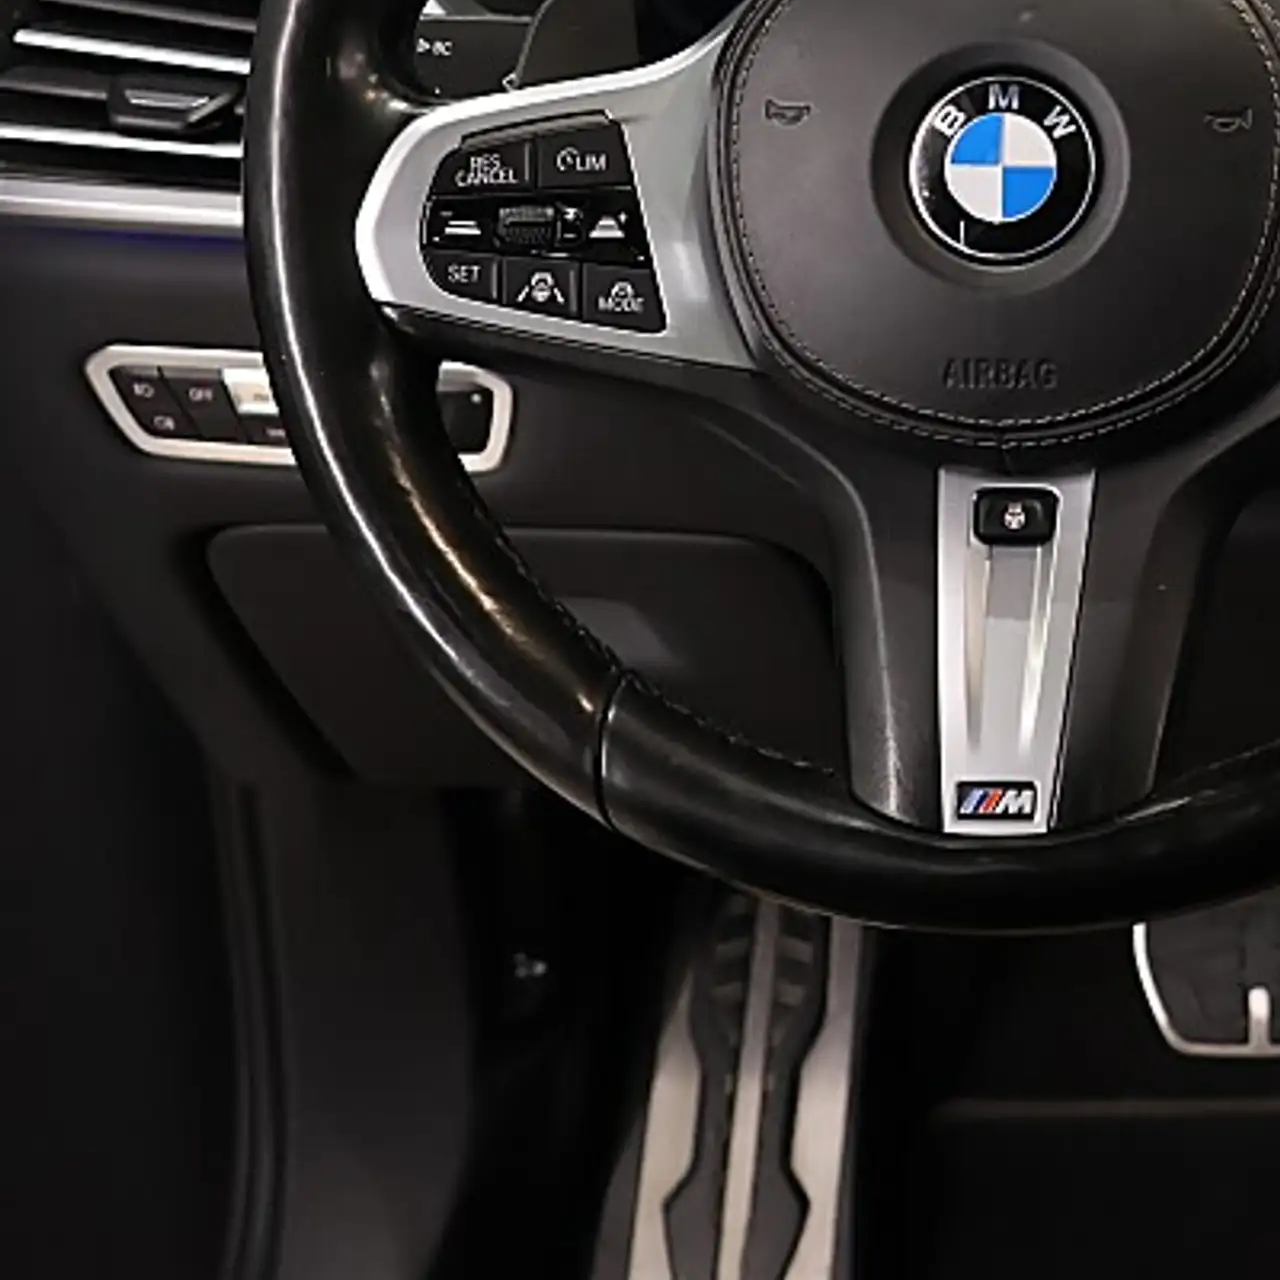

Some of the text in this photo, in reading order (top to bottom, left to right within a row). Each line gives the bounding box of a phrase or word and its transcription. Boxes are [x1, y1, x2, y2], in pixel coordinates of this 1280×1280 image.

[932, 83, 1078, 141] BMW
[470, 153, 501, 171] RES
[576, 153, 607, 171] LIM
[455, 169, 518, 187] CANCEL
[447, 264, 481, 283] SET
[597, 295, 645, 313] MODE
[942, 355, 1058, 390] AIRBAG
